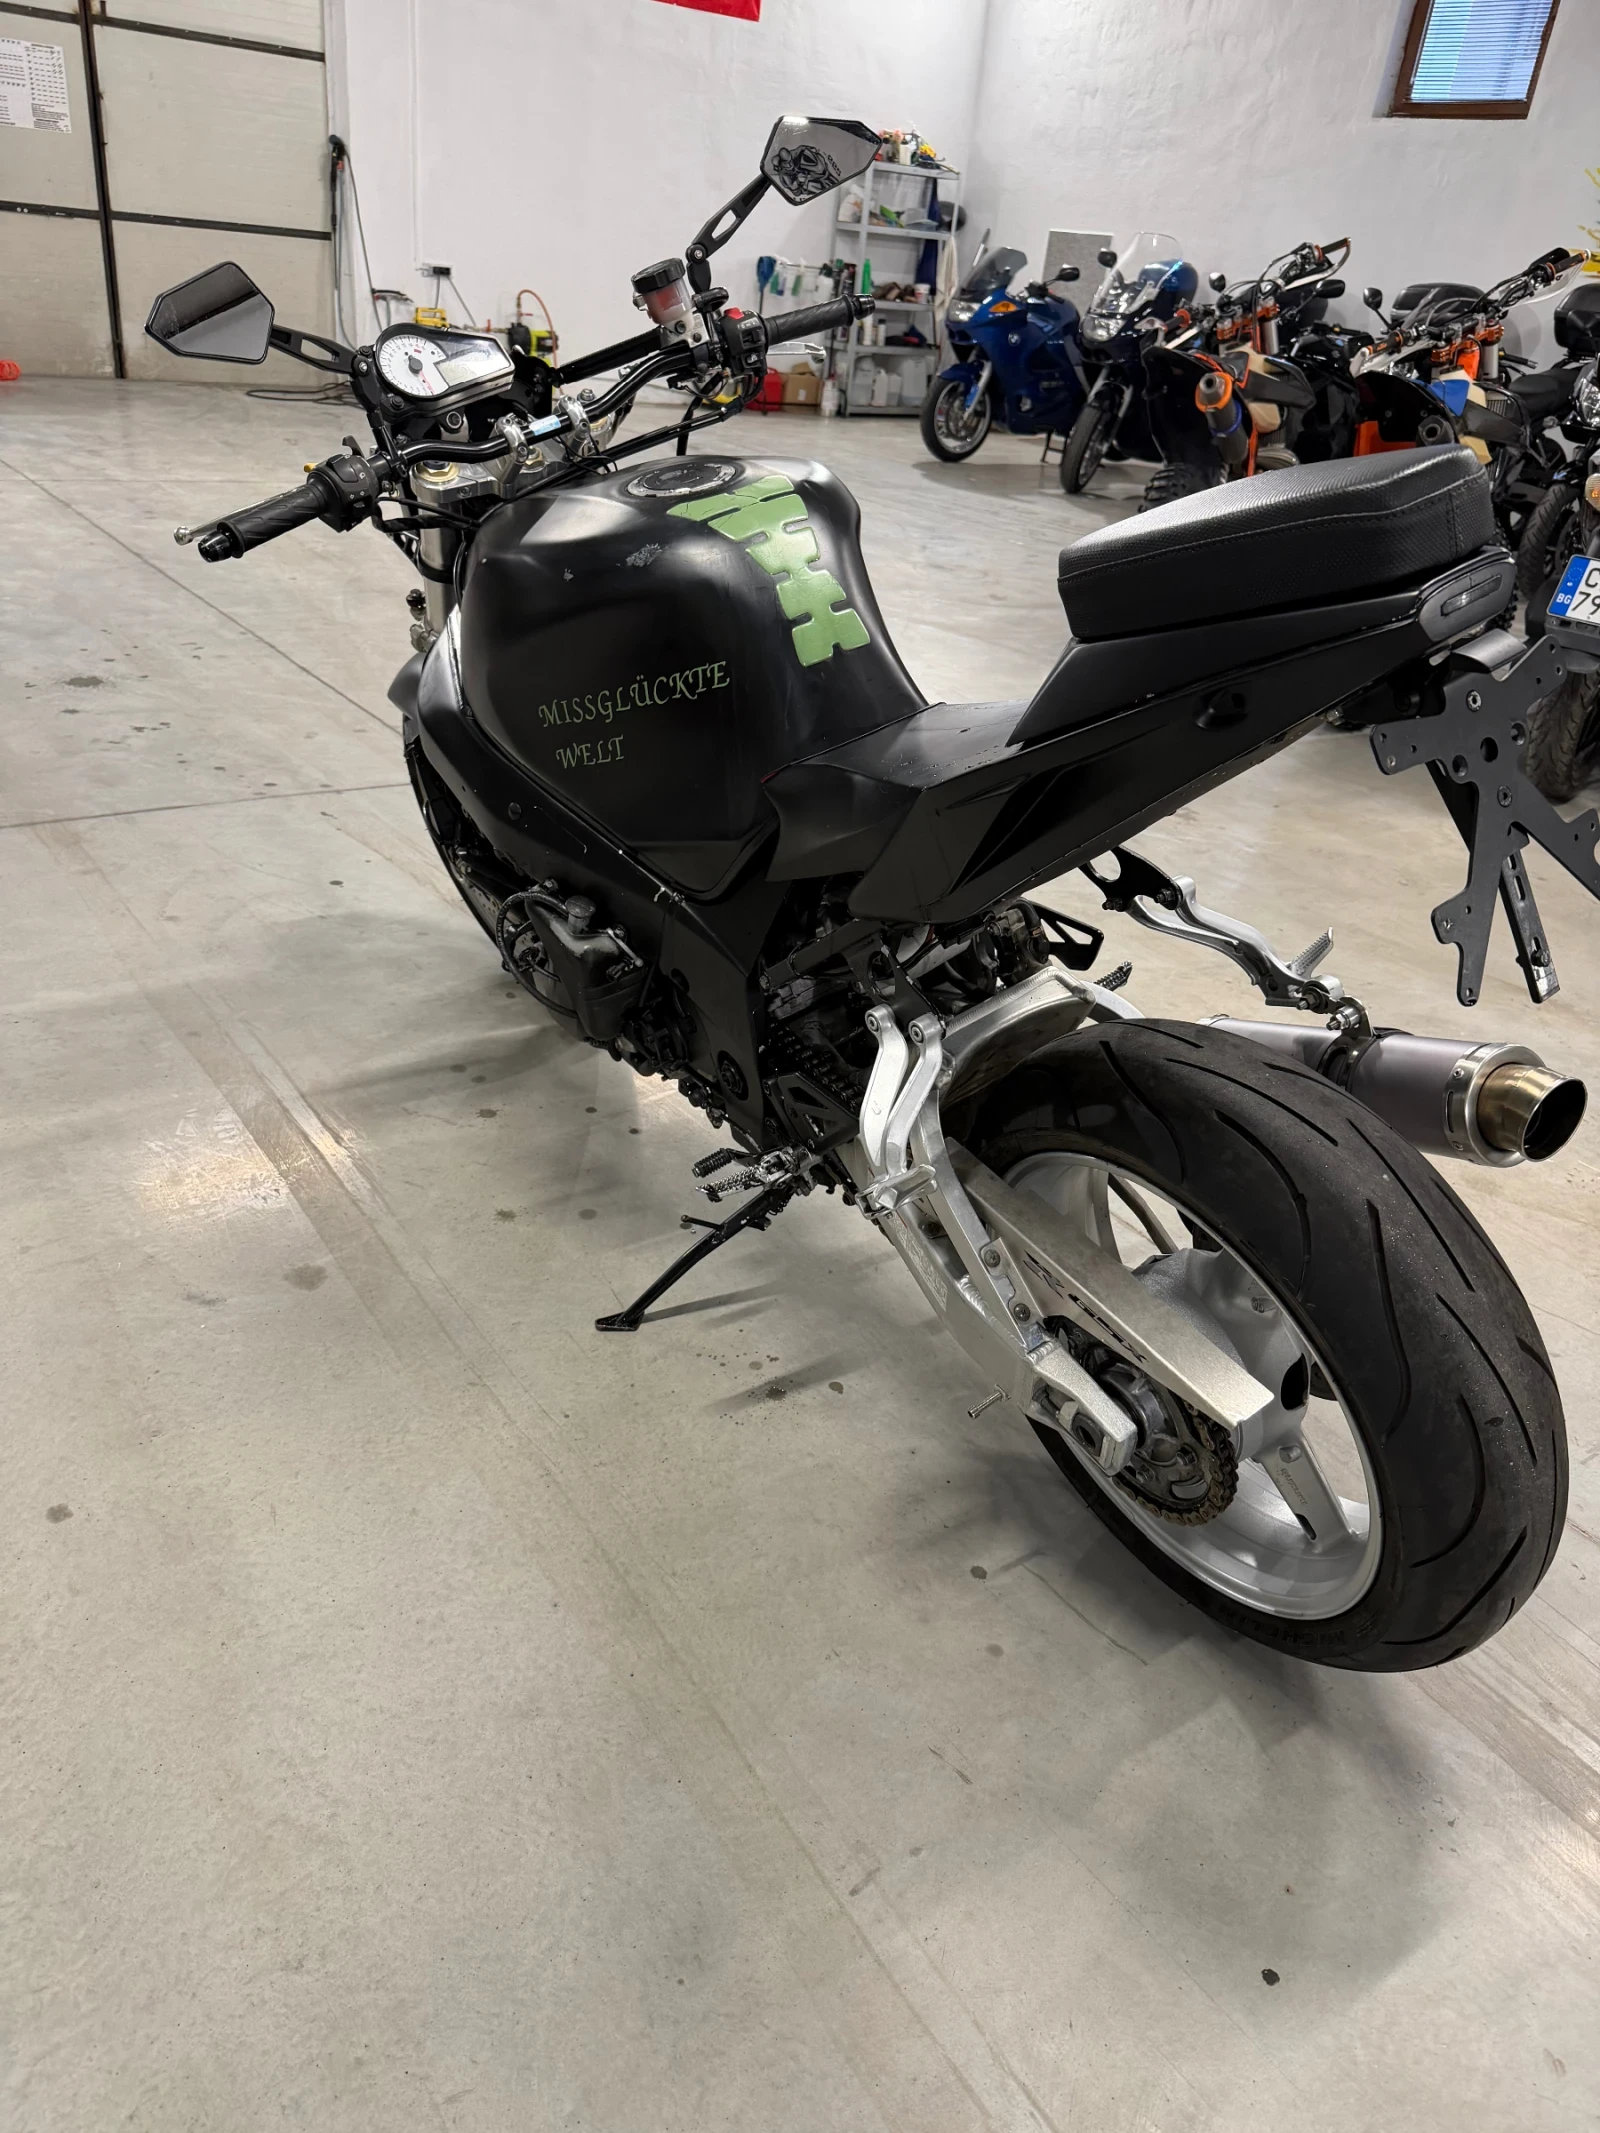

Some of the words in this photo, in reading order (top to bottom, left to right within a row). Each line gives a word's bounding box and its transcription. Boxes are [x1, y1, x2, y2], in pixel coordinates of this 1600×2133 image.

[1556, 592, 1572, 605] BG
[1572, 591, 1600, 615] 79
[538, 660, 730, 728] MISSGLÜCKTE
[556, 734, 625, 770] WELT
[1067, 1293, 1148, 1363] GSX
